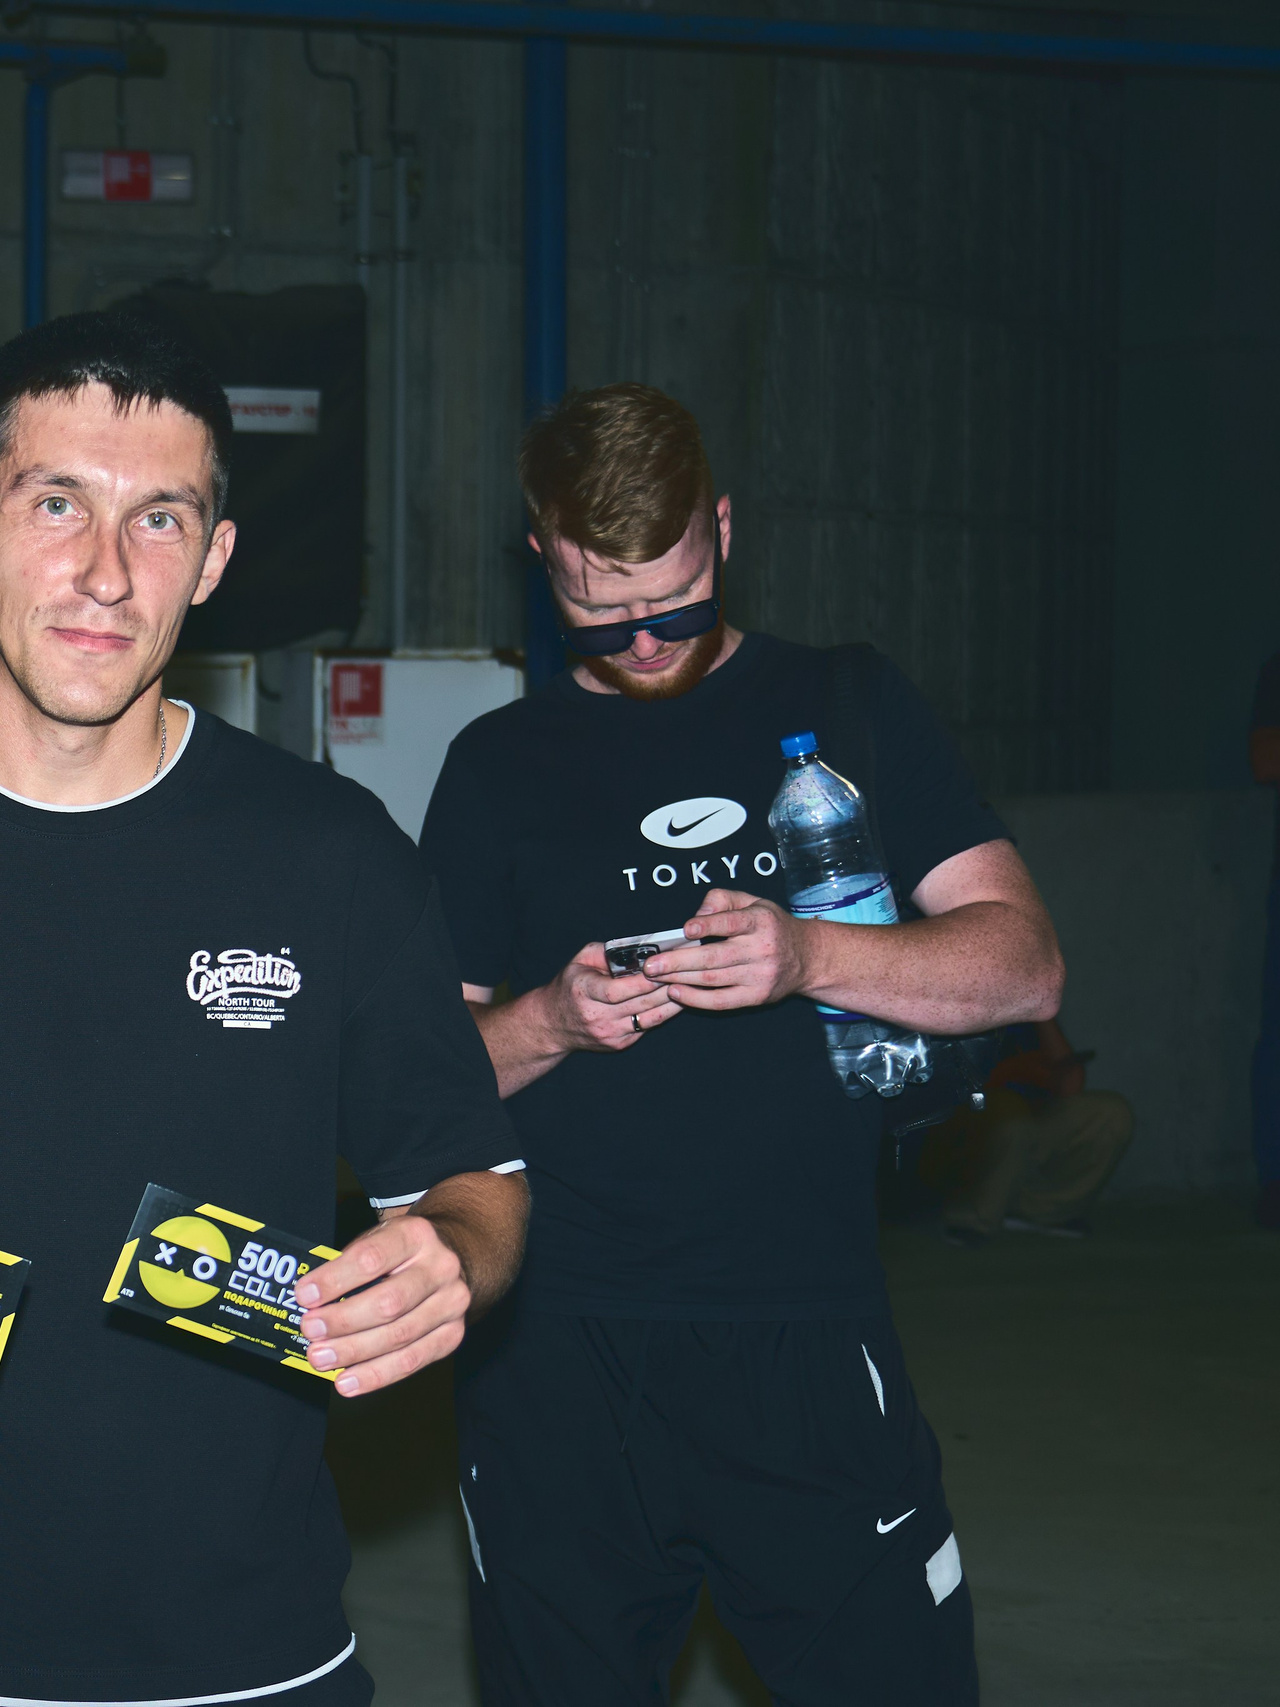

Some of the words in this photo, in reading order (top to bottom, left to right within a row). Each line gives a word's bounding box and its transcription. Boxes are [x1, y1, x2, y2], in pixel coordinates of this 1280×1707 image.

[622, 852, 777, 891] TOKYO
[186, 948, 301, 1005] Expedition
[218, 997, 250, 1007] NORTH
[251, 998, 275, 1008] TOUR
[223, 1290, 288, 1320] ПОДАРОЧНЫЙ
